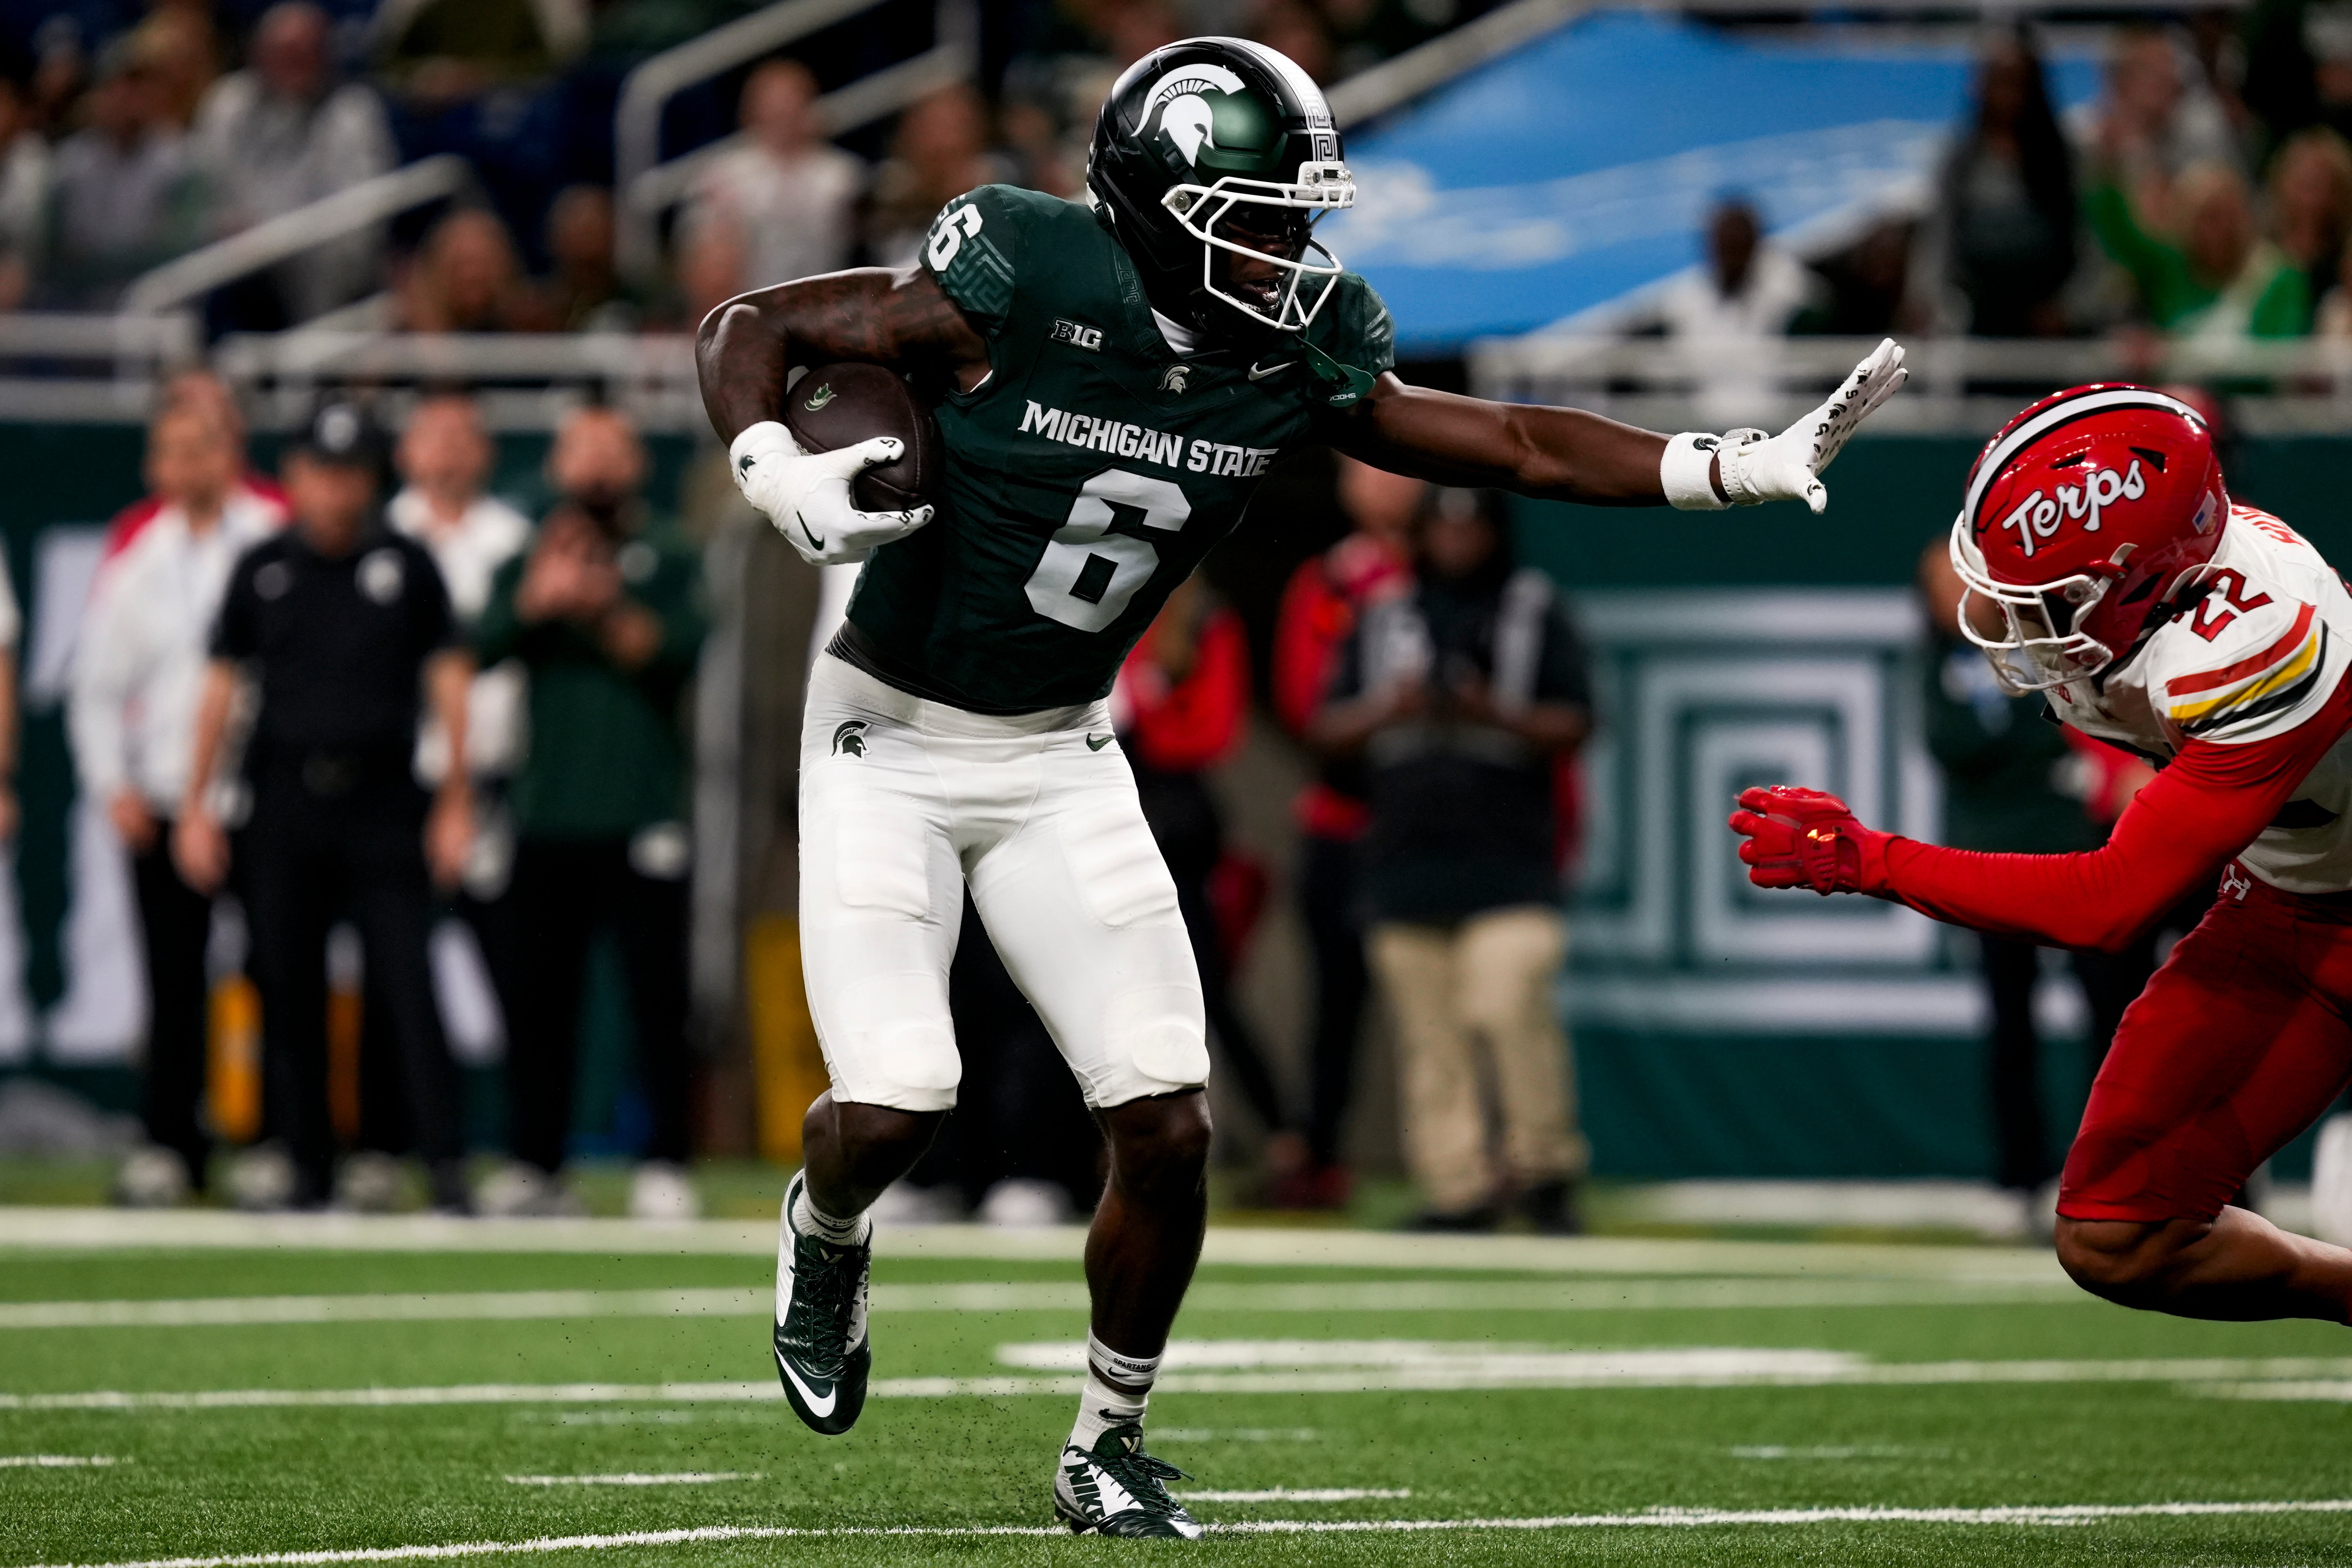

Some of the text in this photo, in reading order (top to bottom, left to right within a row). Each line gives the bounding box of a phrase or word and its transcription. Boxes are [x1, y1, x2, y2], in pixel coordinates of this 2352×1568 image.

[927, 203, 983, 271] 6
[1329, 393, 1356, 401] SHOCK
[1017, 399, 1279, 477] MICHIGAN STATE
[2003, 459, 2145, 557] Terps
[1023, 467, 1192, 633] 6
[2171, 567, 2274, 643] 22
[1113, 1358, 1151, 1370] SPARTANS
[1064, 1463, 1106, 1524] NIKE
